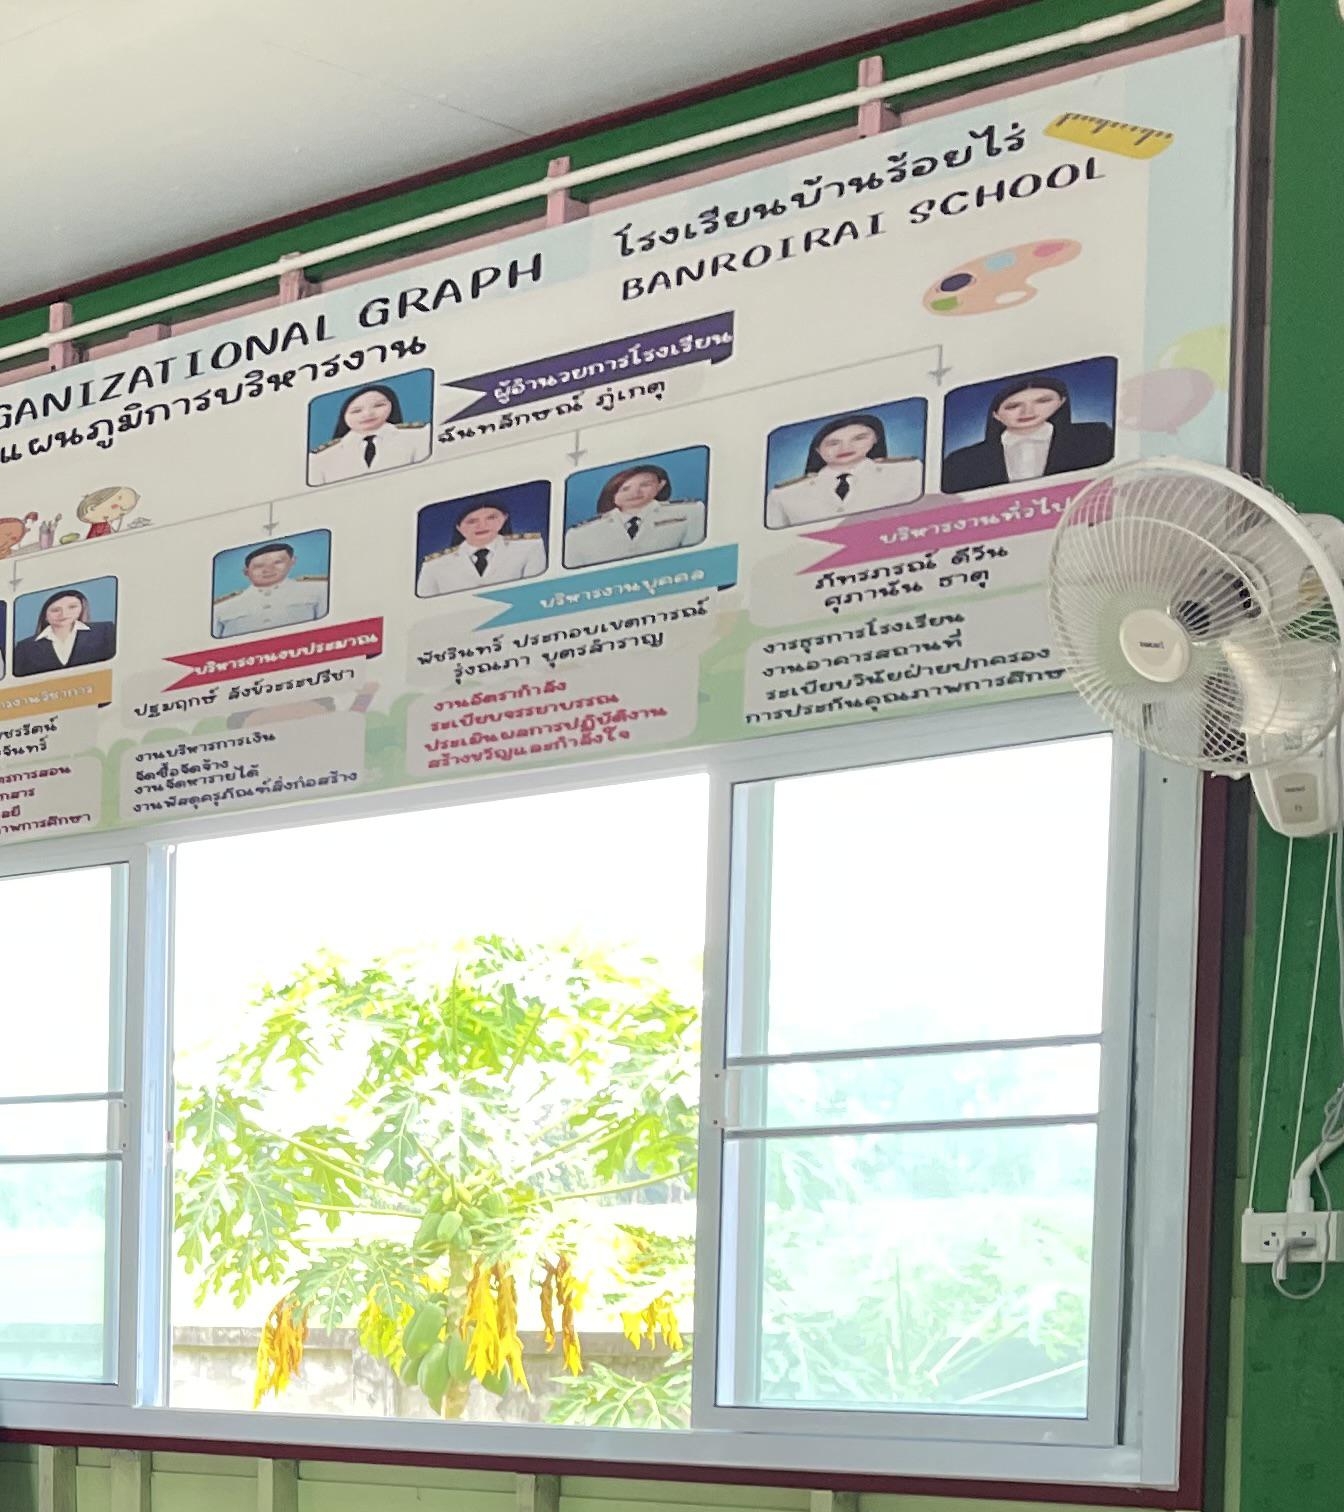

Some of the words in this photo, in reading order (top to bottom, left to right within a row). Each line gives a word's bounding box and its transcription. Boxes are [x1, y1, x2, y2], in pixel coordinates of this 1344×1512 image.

[614, 122, 1027, 258] โรงเรียนบ้านร้อยไร่
[622, 211, 888, 301] BANROIRAI
[910, 156, 1106, 225] SCHOOL
[359, 252, 543, 328] GRAPH
[1, 336, 426, 463] แผนภูมิการบริหารงาน
[494, 330, 733, 405] ผู้อำนวยการโรงเรียน
